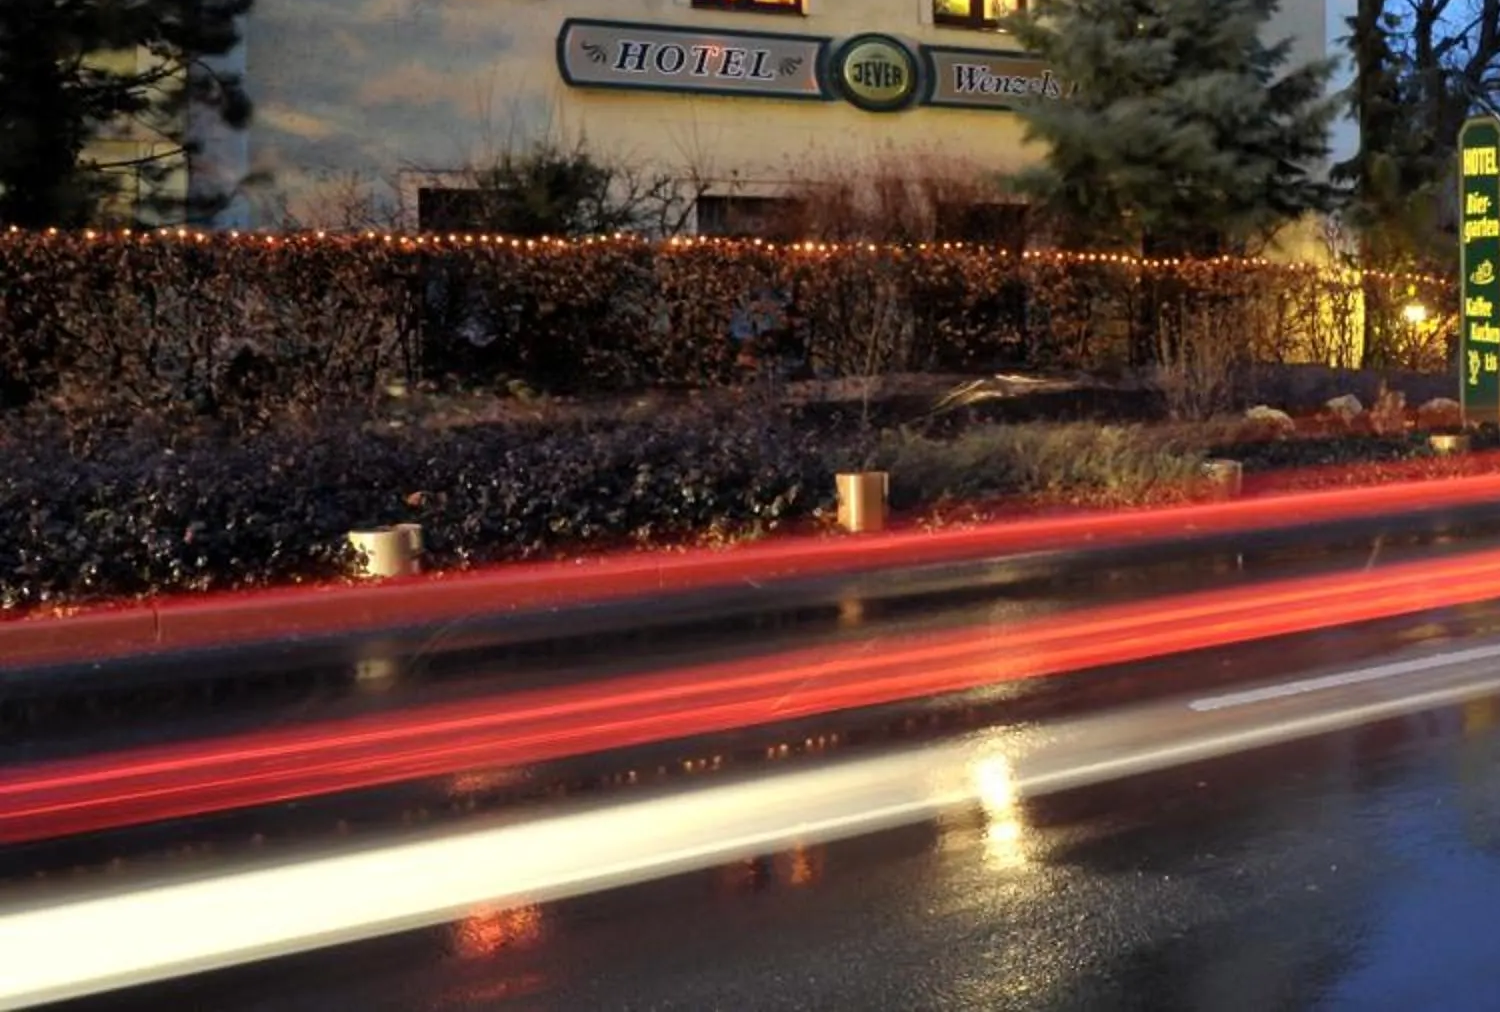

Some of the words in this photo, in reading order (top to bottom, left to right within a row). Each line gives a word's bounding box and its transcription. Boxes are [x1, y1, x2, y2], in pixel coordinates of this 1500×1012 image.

[613, 39, 776, 80] HOTEL
[852, 61, 903, 88] JEVER
[1463, 147, 1499, 176] HOTEL
